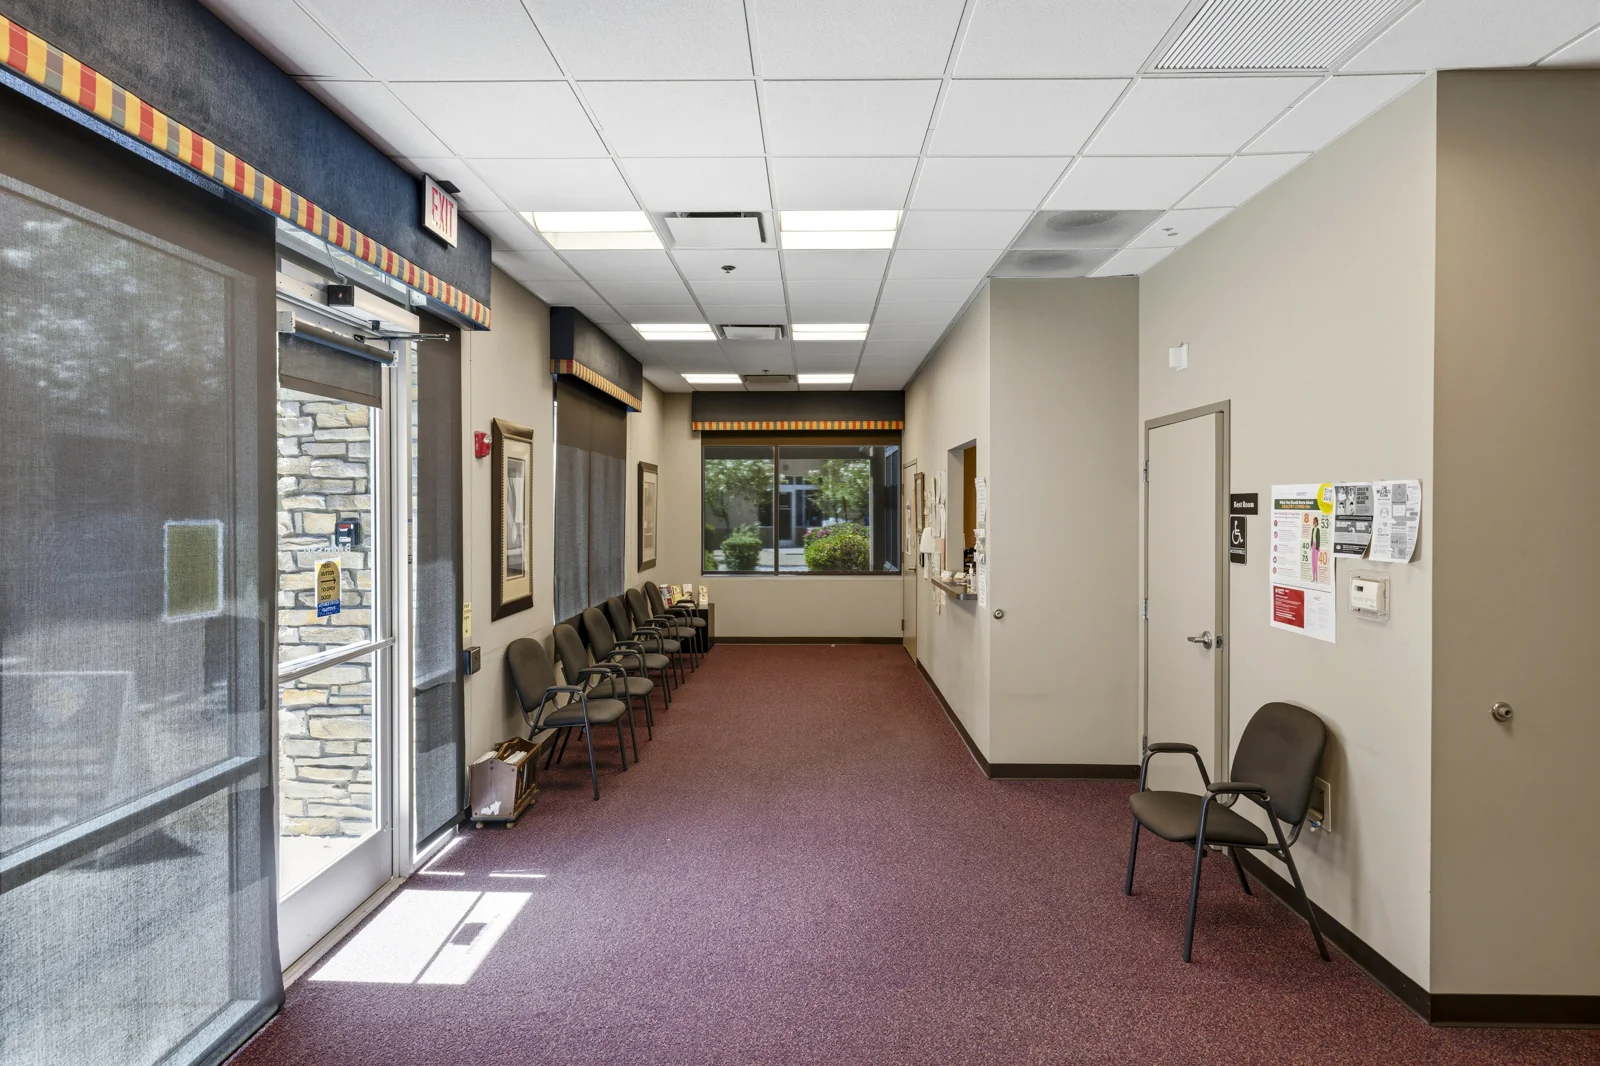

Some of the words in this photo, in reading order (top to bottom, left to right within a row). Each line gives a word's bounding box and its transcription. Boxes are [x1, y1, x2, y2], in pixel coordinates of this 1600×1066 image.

[431, 186, 454, 238] EXIT
[1304, 513, 1309, 523] 8
[1319, 552, 1327, 565] 40
